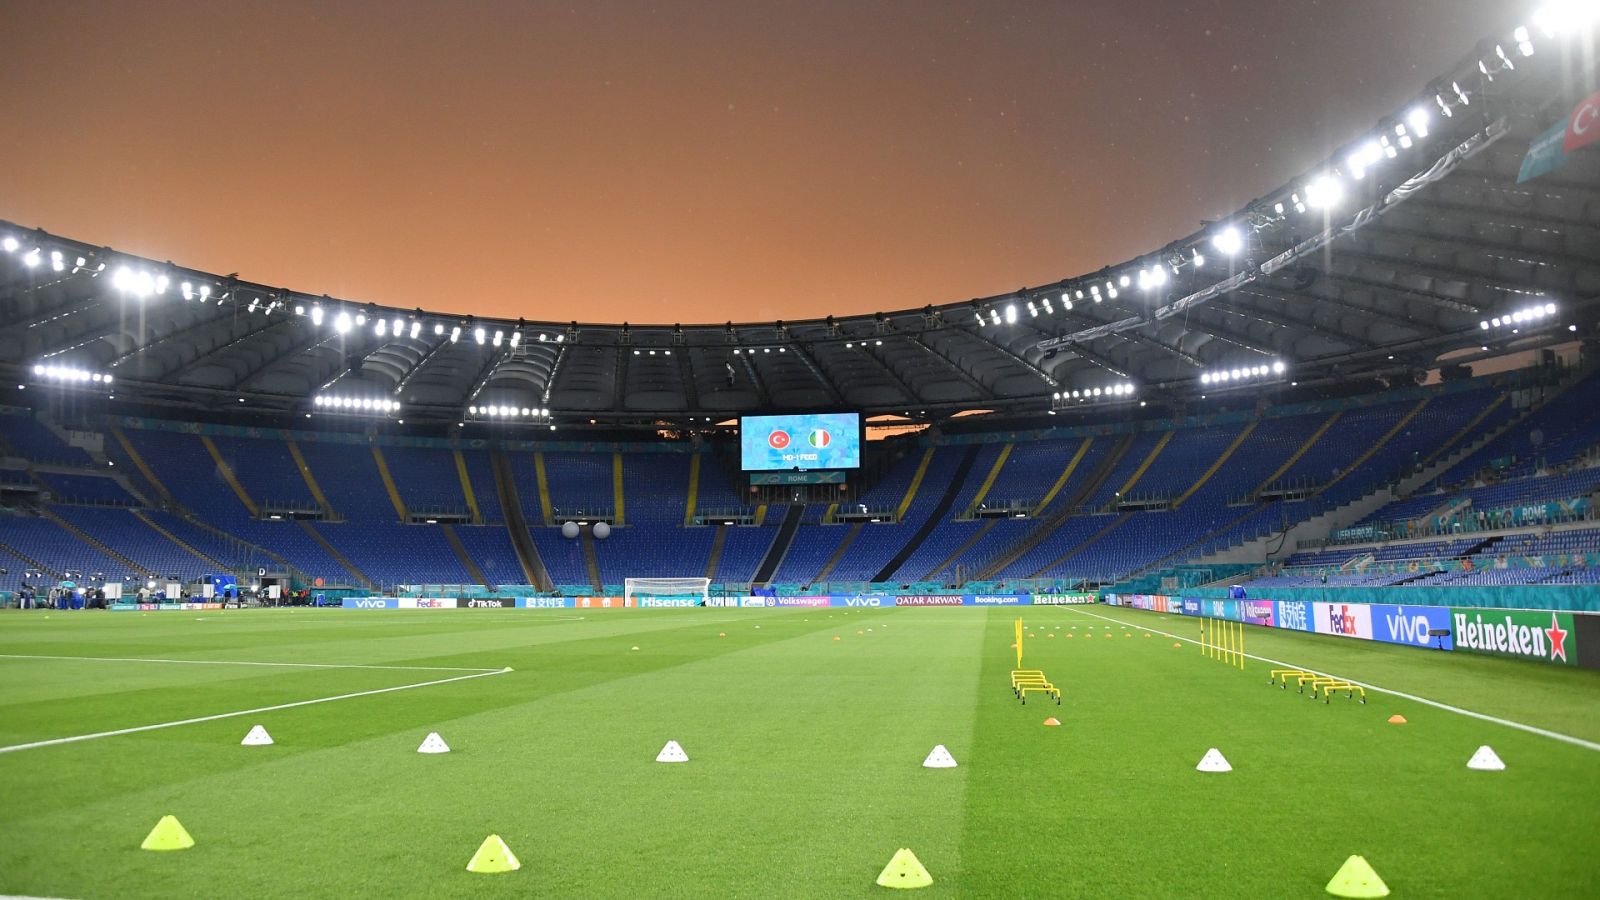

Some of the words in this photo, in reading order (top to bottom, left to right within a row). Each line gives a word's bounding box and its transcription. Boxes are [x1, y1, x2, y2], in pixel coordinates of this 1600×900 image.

[788, 475, 808, 483] ROME
[1522, 504, 1547, 521] ROME
[259, 568, 266, 576] D
[355, 599, 386, 608] vivo
[416, 599, 442, 608] FedEx
[476, 599, 503, 608] TikTok
[641, 596, 696, 607] Hisense
[778, 596, 827, 606] Volkswagen
[845, 596, 880, 607] vivo
[896, 596, 925, 605] QATAR
[926, 595, 963, 605] AIRWAYS
[975, 595, 1019, 605] Booking.com
[1033, 594, 1085, 604] Heineken
[1330, 604, 1356, 635] FedEx
[1386, 606, 1430, 645] vivo
[1454, 612, 1547, 657] Heineken
